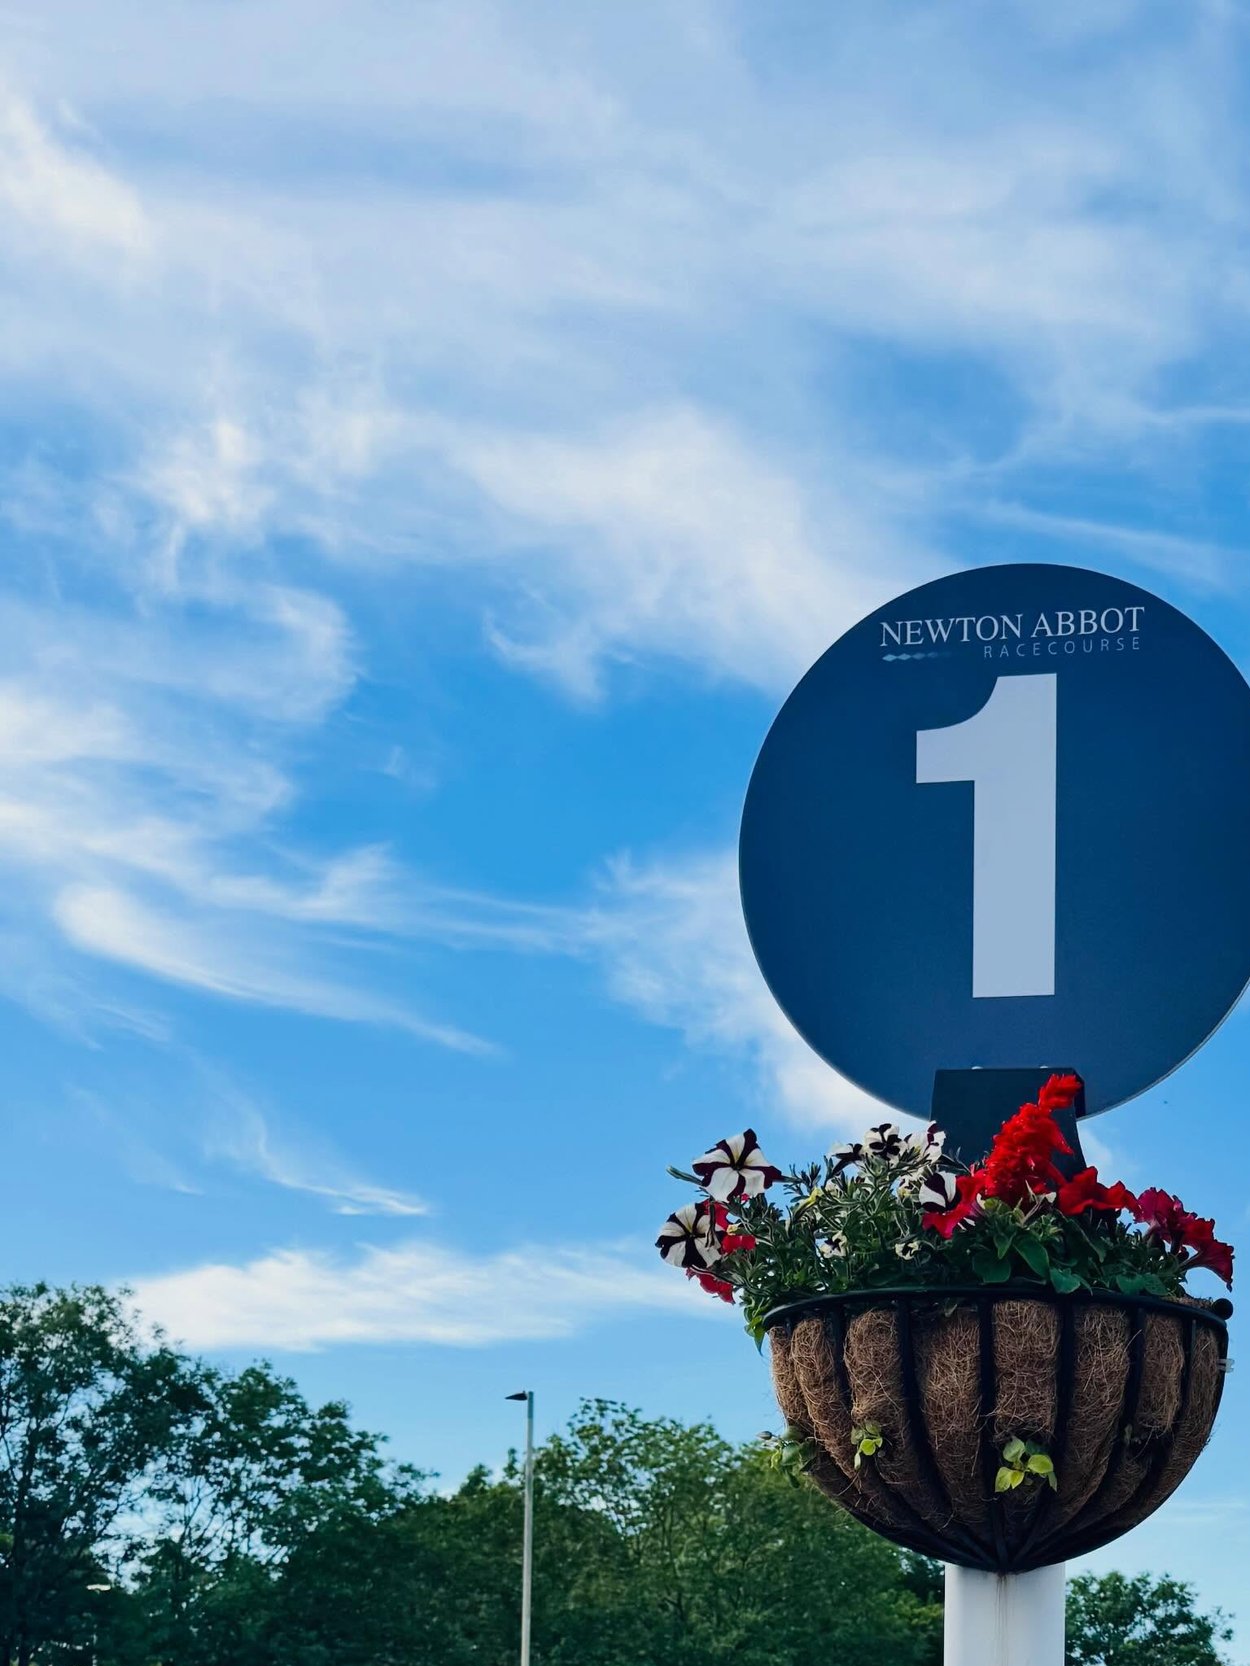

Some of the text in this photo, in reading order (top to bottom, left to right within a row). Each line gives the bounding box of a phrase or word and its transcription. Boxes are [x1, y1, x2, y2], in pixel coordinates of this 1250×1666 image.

[880, 606, 1145, 647] NEWTON ABBOT
[983, 637, 1140, 658] RACECOURSE
[916, 673, 1057, 998] 1
